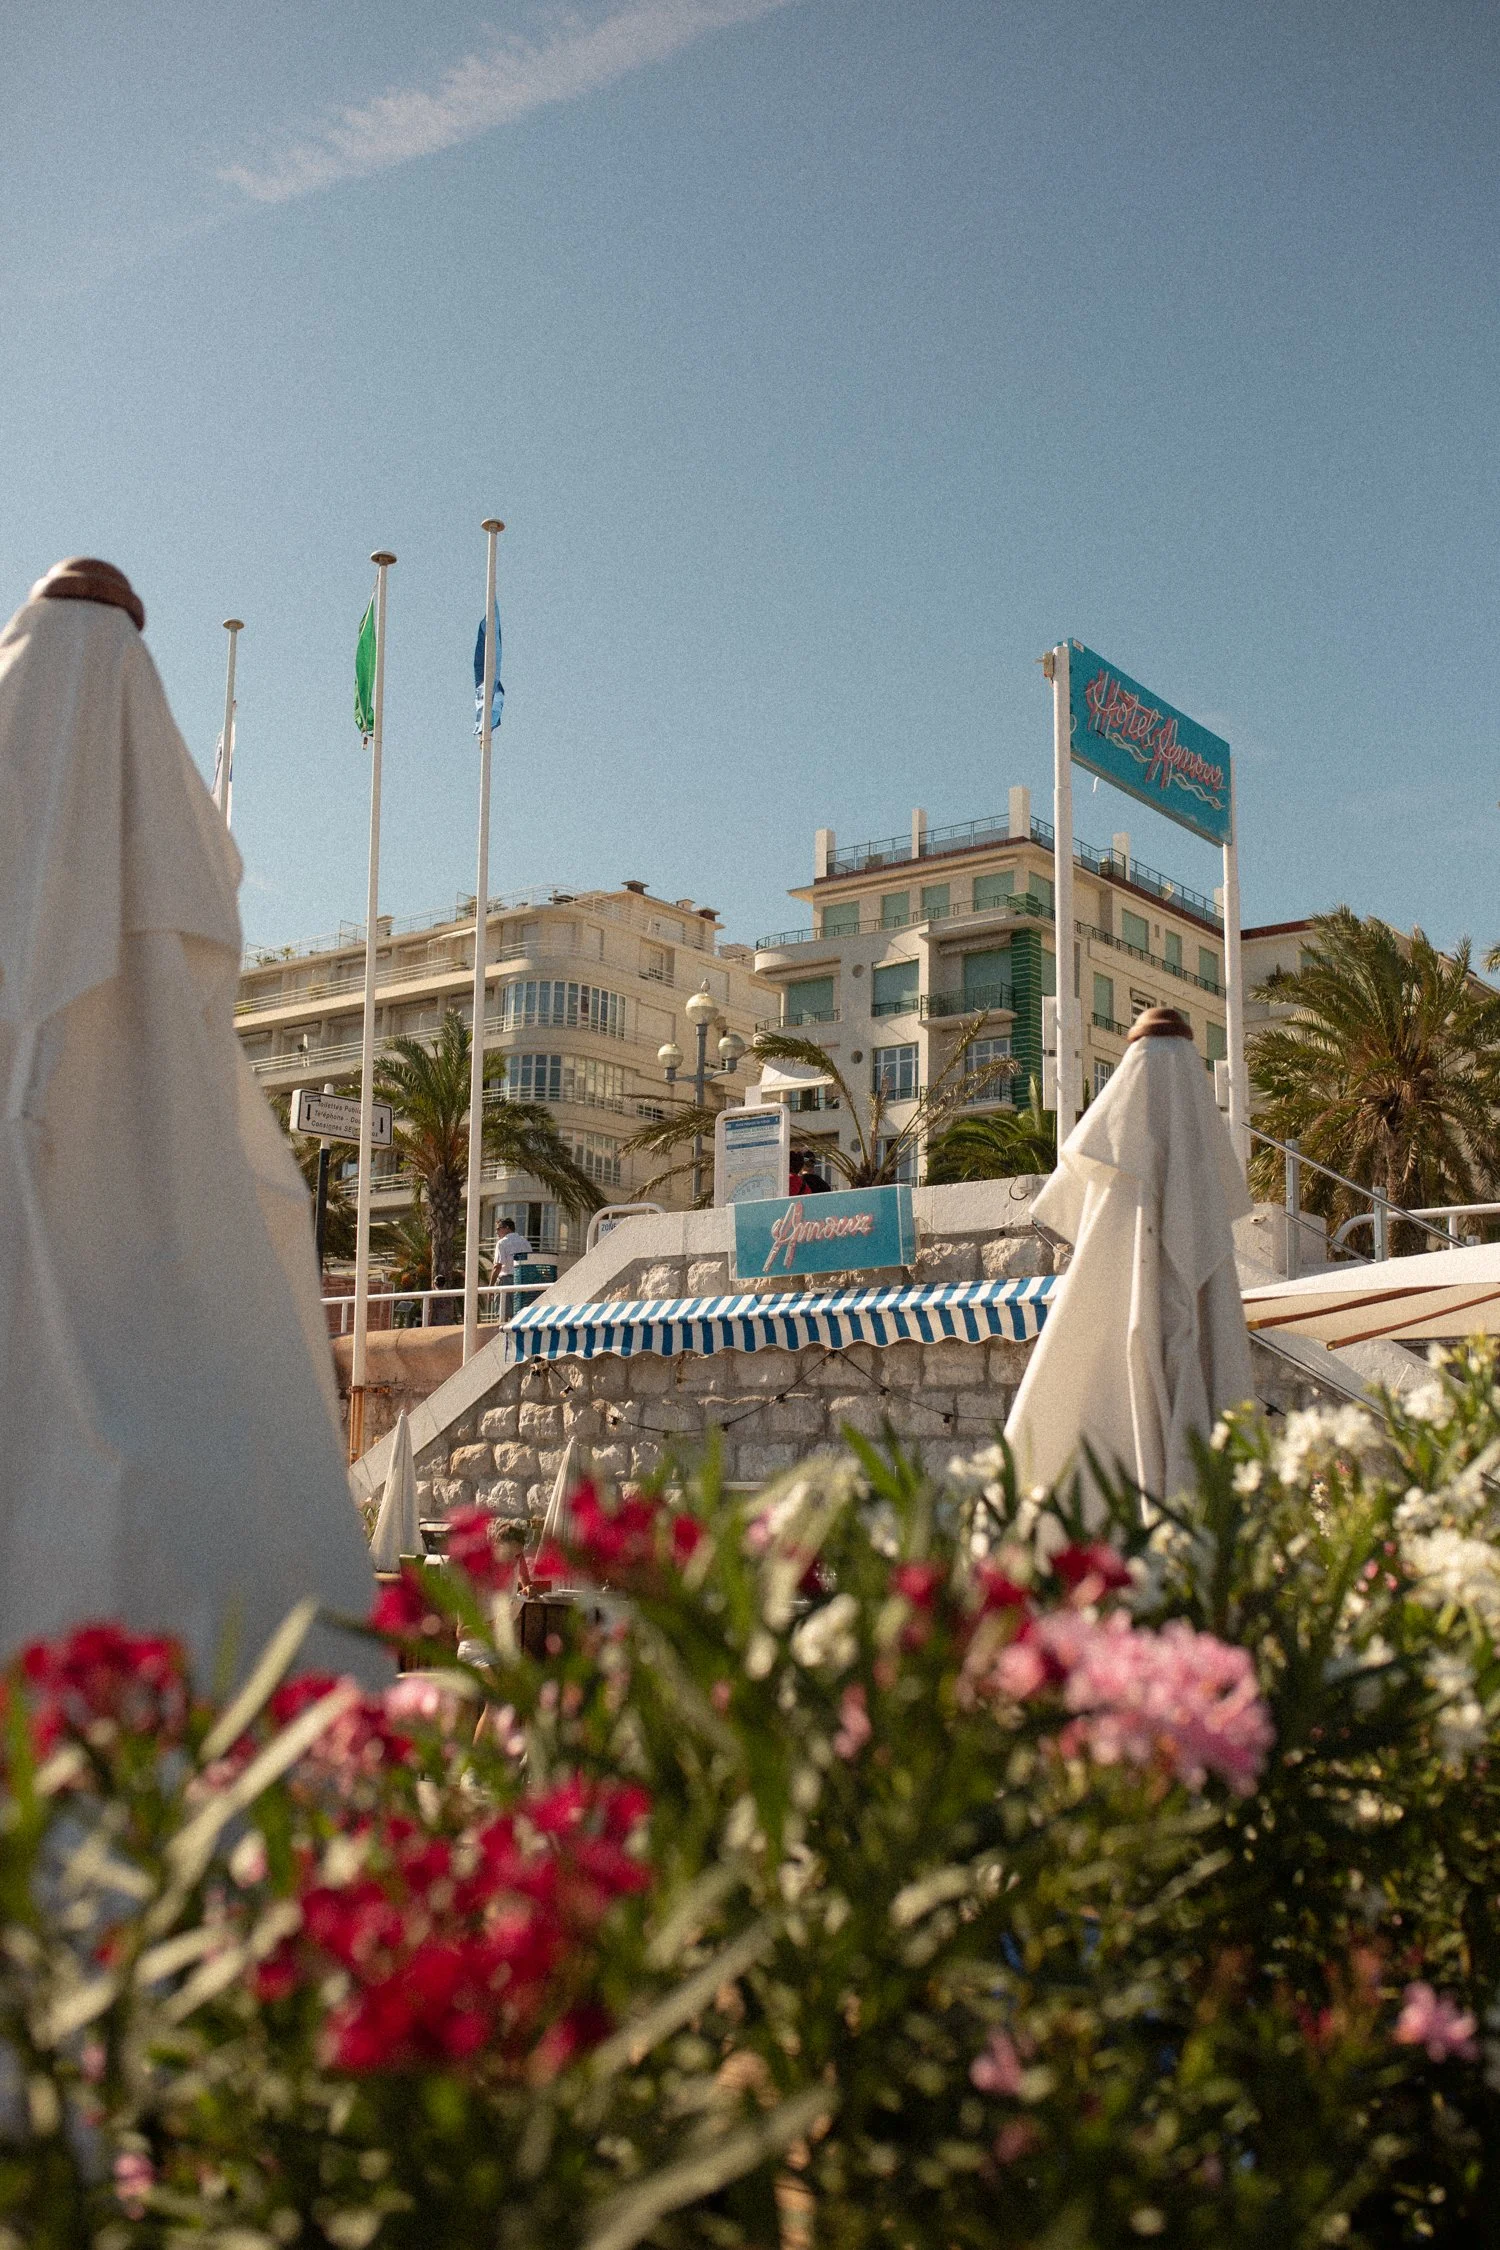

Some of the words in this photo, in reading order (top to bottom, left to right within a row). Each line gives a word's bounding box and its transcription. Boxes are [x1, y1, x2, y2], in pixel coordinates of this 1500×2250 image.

[1146, 717, 1226, 792] Amour
[318, 1102, 342, 1111] Toilettes
[762, 1202, 874, 1272] Amour
